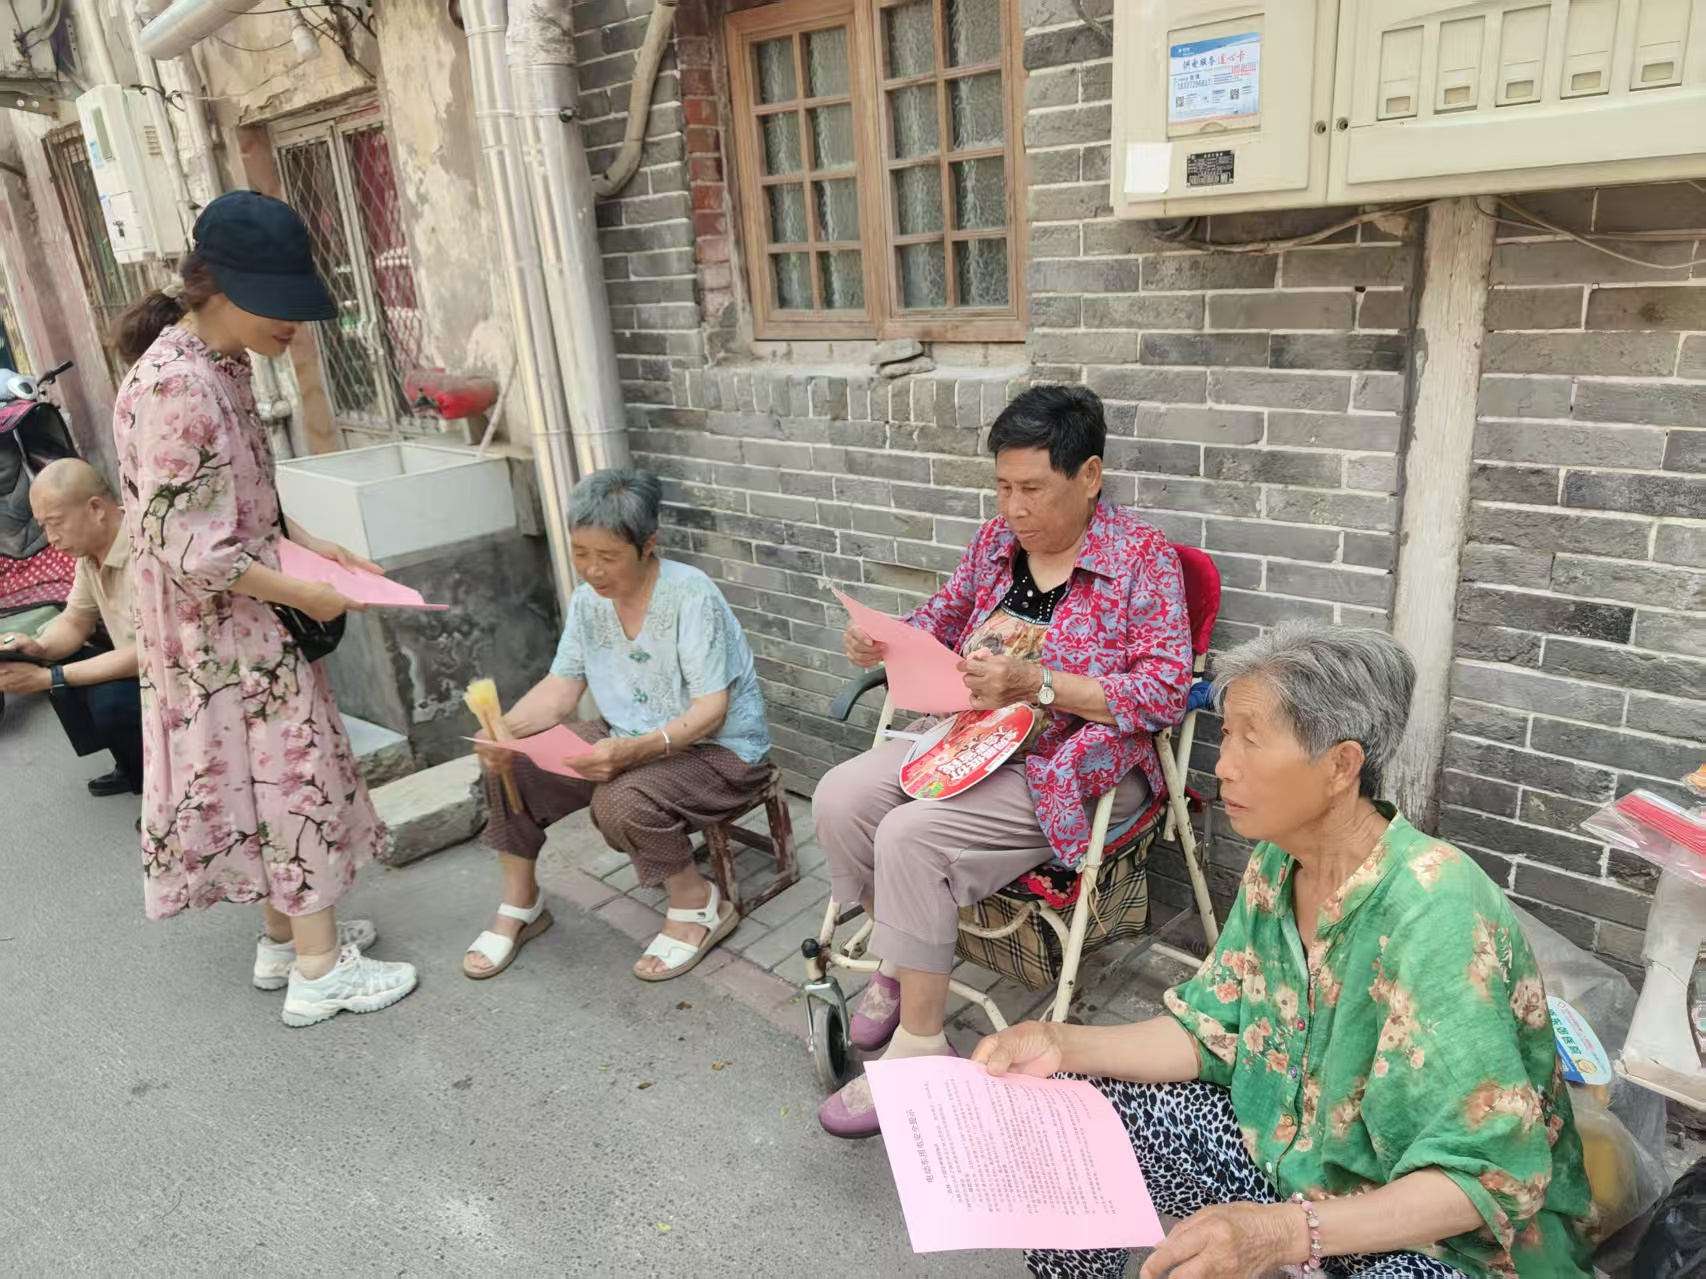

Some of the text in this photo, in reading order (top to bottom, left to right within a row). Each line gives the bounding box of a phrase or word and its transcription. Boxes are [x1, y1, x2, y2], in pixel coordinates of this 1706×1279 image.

[906, 1108, 933, 1183] 电动车用电安全提示
